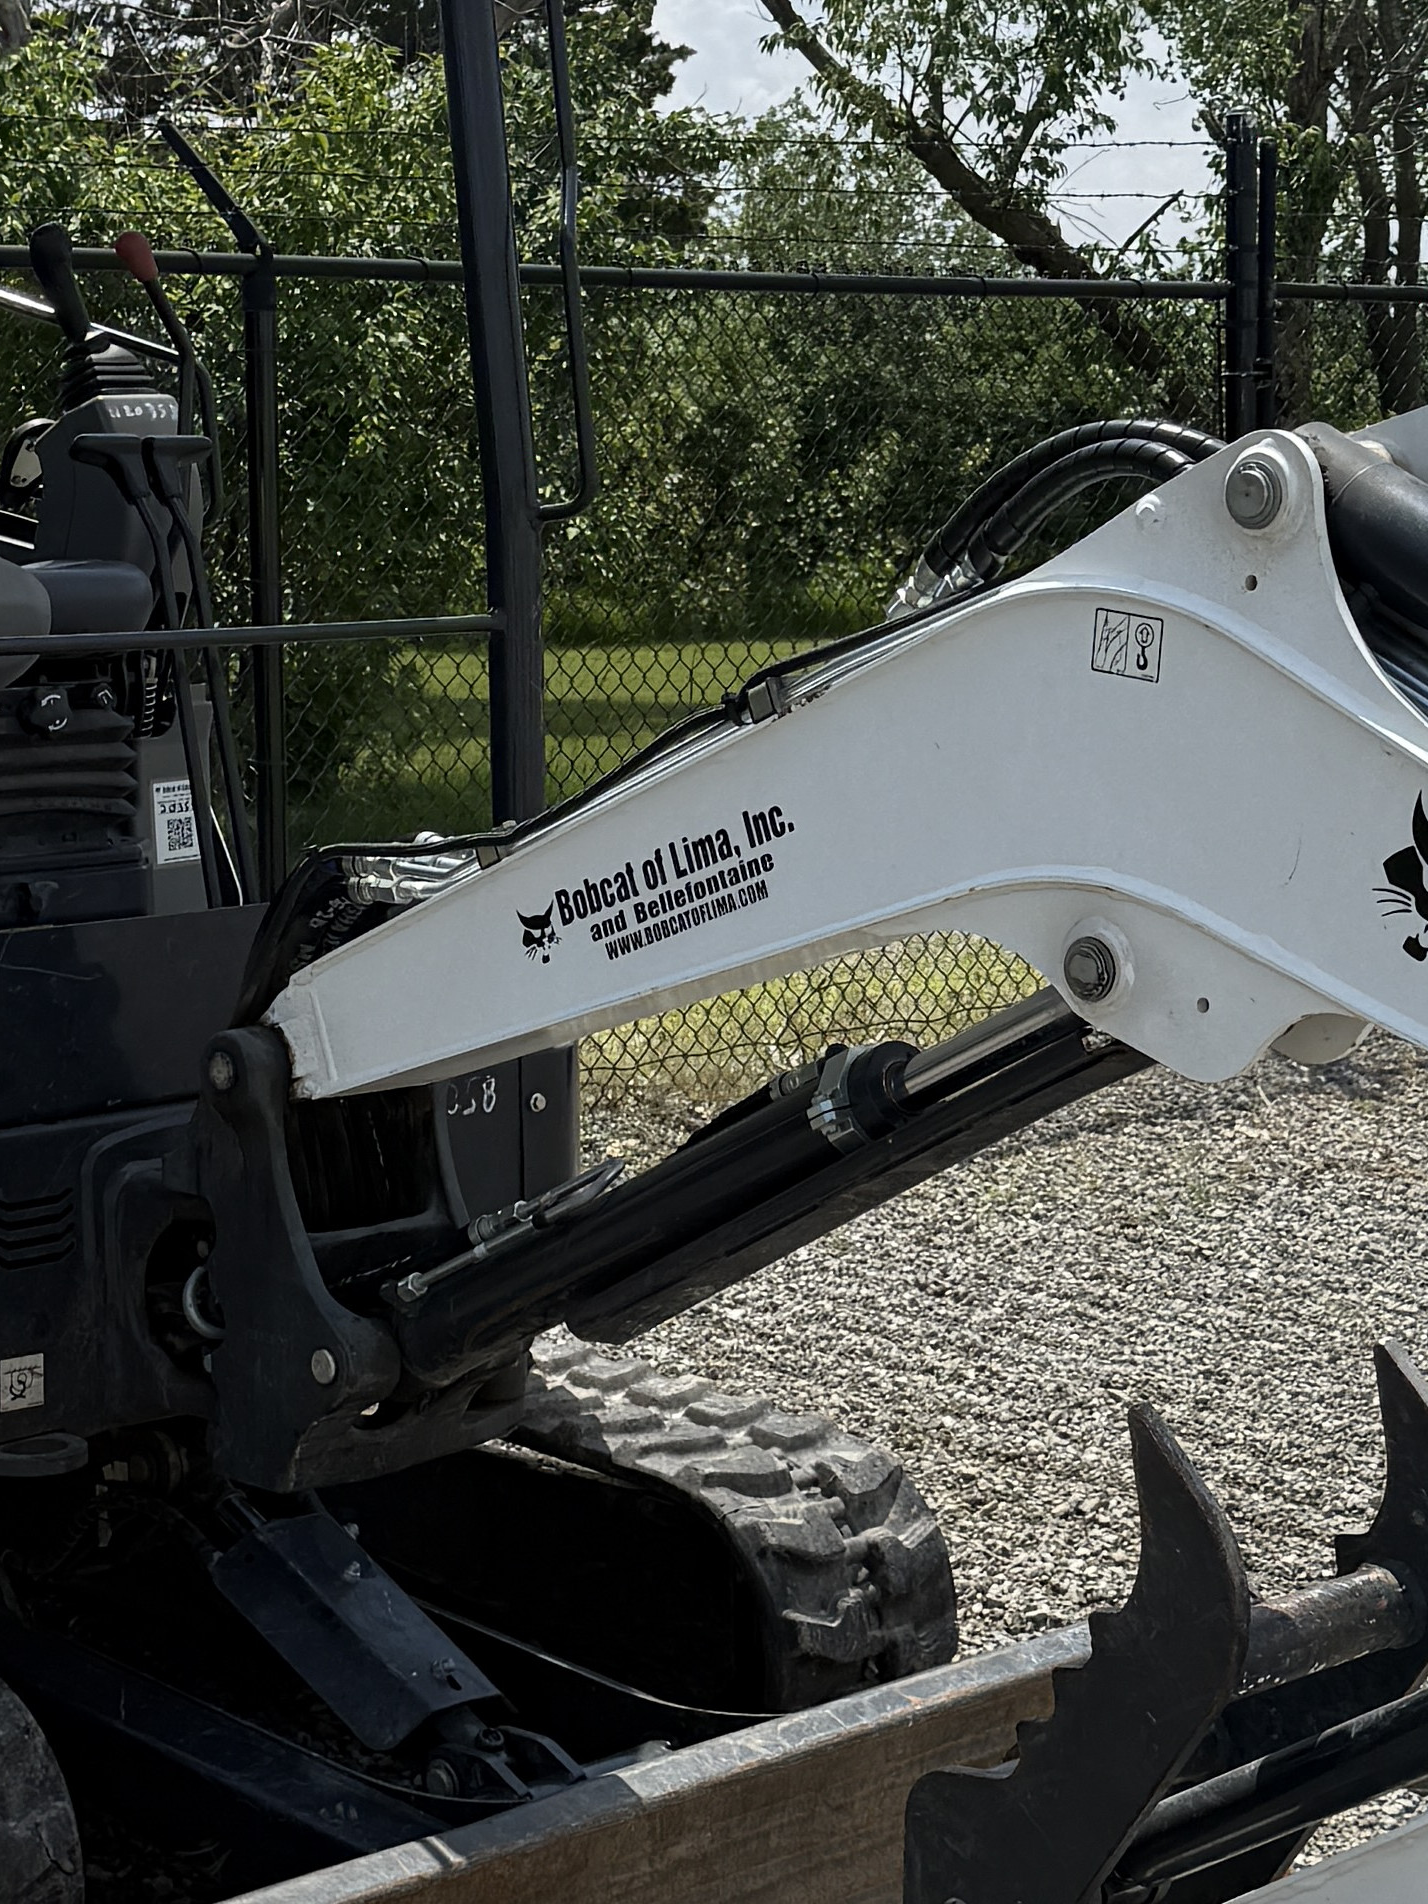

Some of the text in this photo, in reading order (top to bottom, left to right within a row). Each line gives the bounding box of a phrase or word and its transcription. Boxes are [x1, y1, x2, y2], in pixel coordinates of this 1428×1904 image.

[553, 804, 795, 927] Bobcat of Lima, Inc.
[589, 851, 775, 943] and Bellefontaine
[604, 878, 770, 961] WWW.BOBCATOFLIMA.COM
